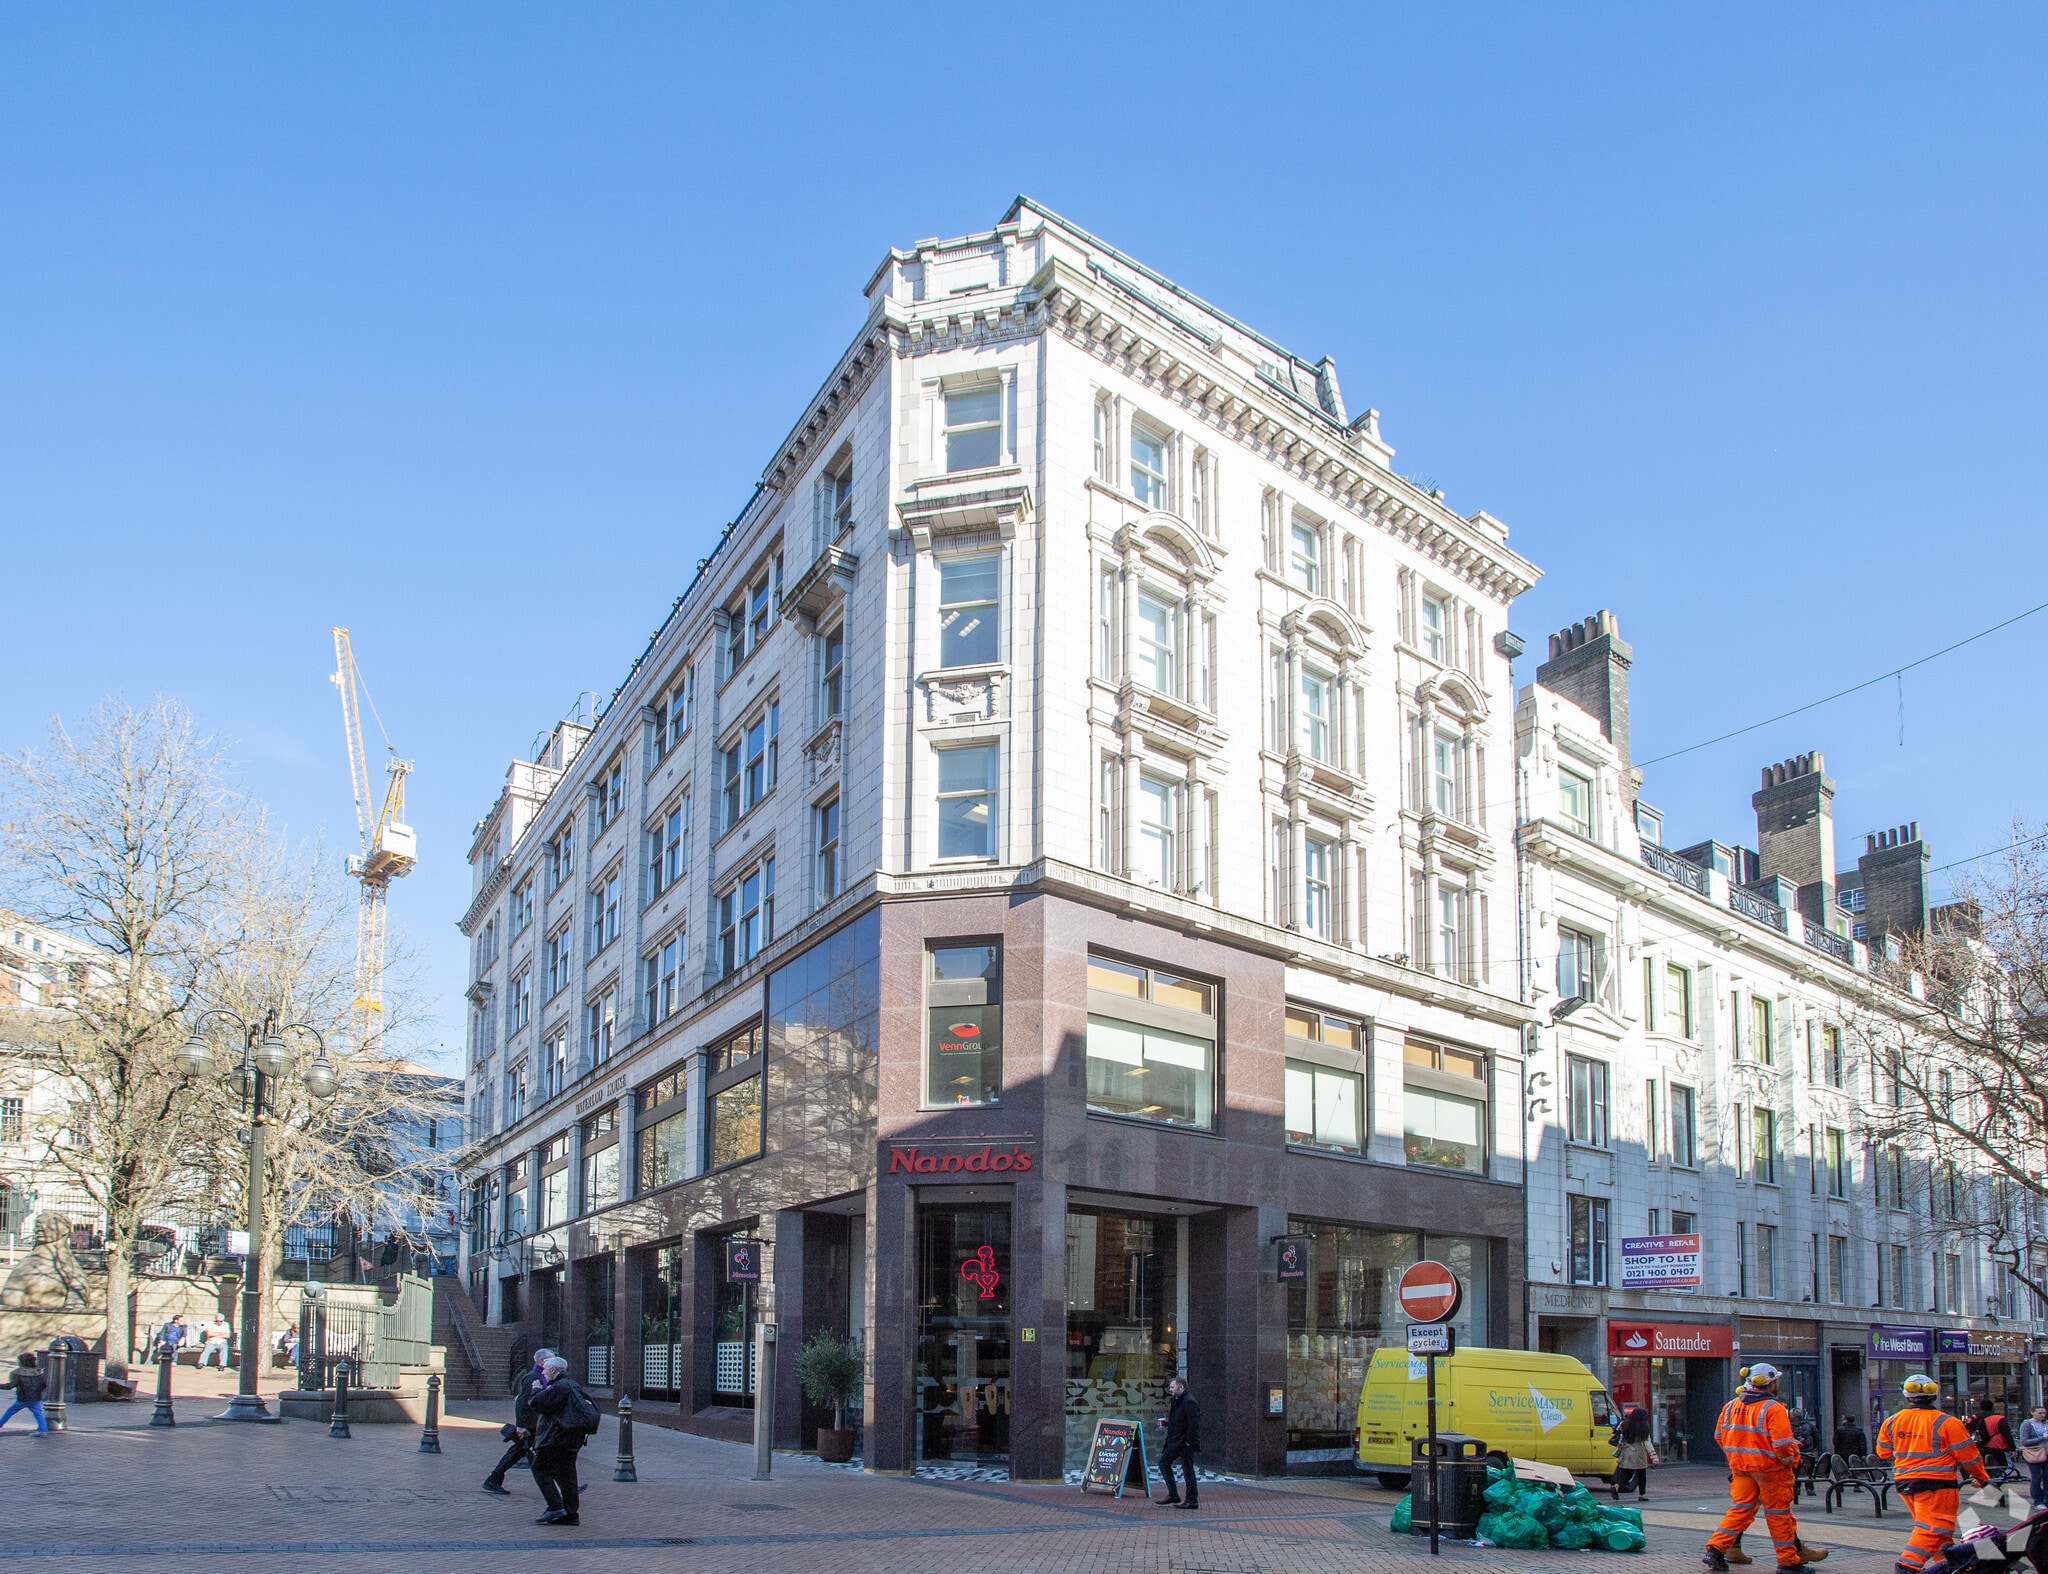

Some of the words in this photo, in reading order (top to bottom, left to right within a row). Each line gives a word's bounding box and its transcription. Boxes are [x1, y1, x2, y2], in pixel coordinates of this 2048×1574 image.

[939, 1041, 990, 1051] VennGroup
[888, 1144, 1032, 1174] Nando's
[1625, 1241, 1664, 1250] CREATIVE
[1625, 1256, 1655, 1265] SHOP
[1658, 1255, 1674, 1263] TO
[1677, 1254, 1697, 1262] LET
[1626, 1270, 1645, 1278] 0121
[1670, 1268, 1695, 1276] 0407
[1625, 1277, 1697, 1286] www.creative-retail.co.uk
[1544, 1294, 1594, 1309] MEDICINE
[1411, 1327, 1443, 1337] Except
[1413, 1338, 1441, 1348] cycles
[1655, 1331, 1712, 1351] Santander
[1968, 1343, 2000, 1356] WILDWOOD
[1374, 1359, 1446, 1369] ServiceMASER
[1540, 1410, 1562, 1421] Clean
